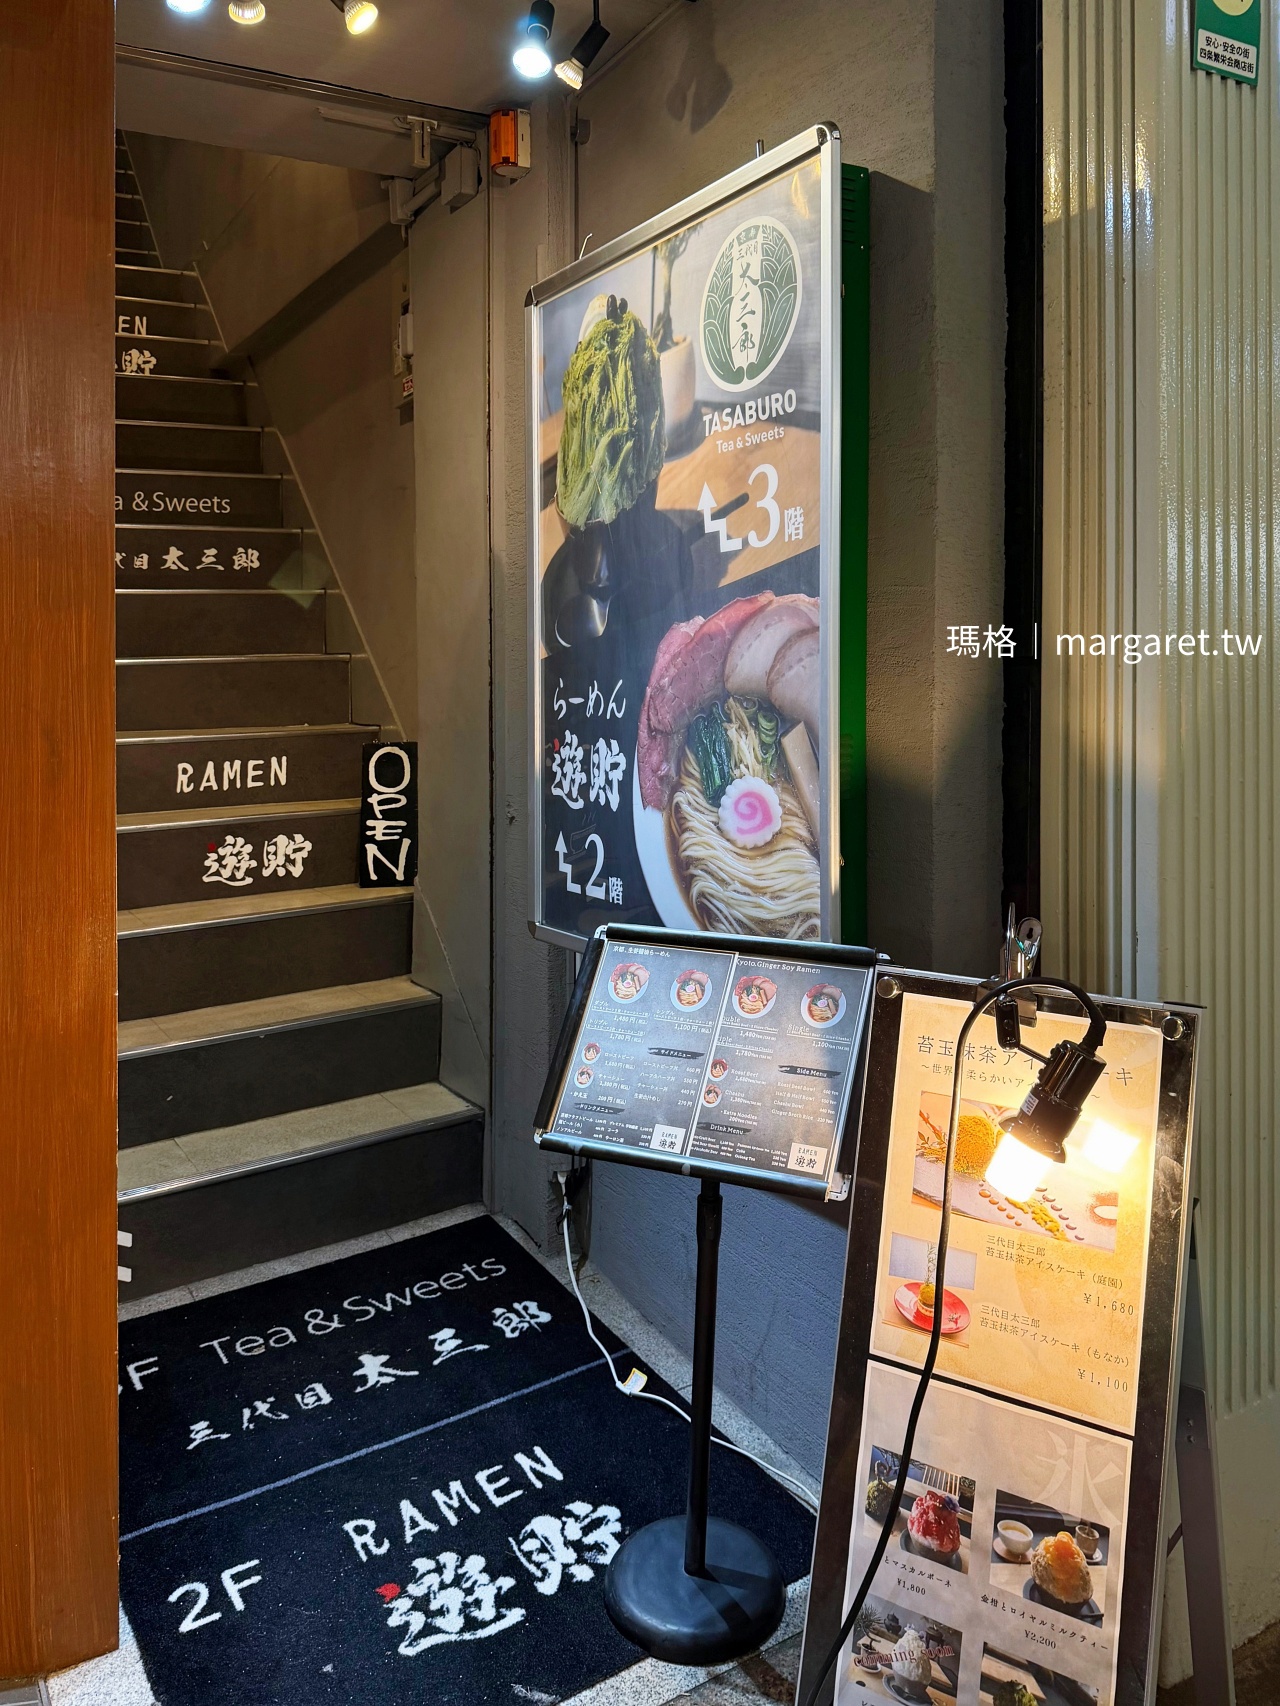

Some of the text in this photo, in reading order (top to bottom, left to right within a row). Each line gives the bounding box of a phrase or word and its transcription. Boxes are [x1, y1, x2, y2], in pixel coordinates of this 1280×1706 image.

[703, 389, 797, 436] TASABURO
[716, 425, 785, 453] Tea & Sweets
[132, 491, 148, 511] &
[152, 491, 231, 513] Sweets
[748, 463, 804, 548] 3階
[553, 678, 626, 720] らーめん
[176, 756, 288, 794] RAMEN
[366, 746, 411, 881] OPEN
[585, 833, 623, 906] 2階
[781, 964, 796, 973] Soy
[796, 966, 821, 974] Ramen
[787, 1024, 810, 1033] Single
[810, 1069, 828, 1078] Menu
[710, 1123, 744, 1135] Drink Menu
[986, 1234, 1046, 1257] 三代目太三郎
[200, 1255, 508, 1365] Tea & Sweets
[980, 1304, 1041, 1329] 三代目太三郎
[1083, 1293, 1134, 1316] ¥1,680
[186, 1300, 552, 1450] 三代目太三郎
[1077, 1368, 1128, 1392] ¥1,100
[342, 1445, 564, 1563] RAMEN
[167, 1558, 263, 1634] 2F
[896, 1578, 927, 1596] ¥1,800
[980, 1593, 1109, 1650] 金柑とロイヤルミルクティー
[1023, 1629, 1057, 1650] ¥2,200
